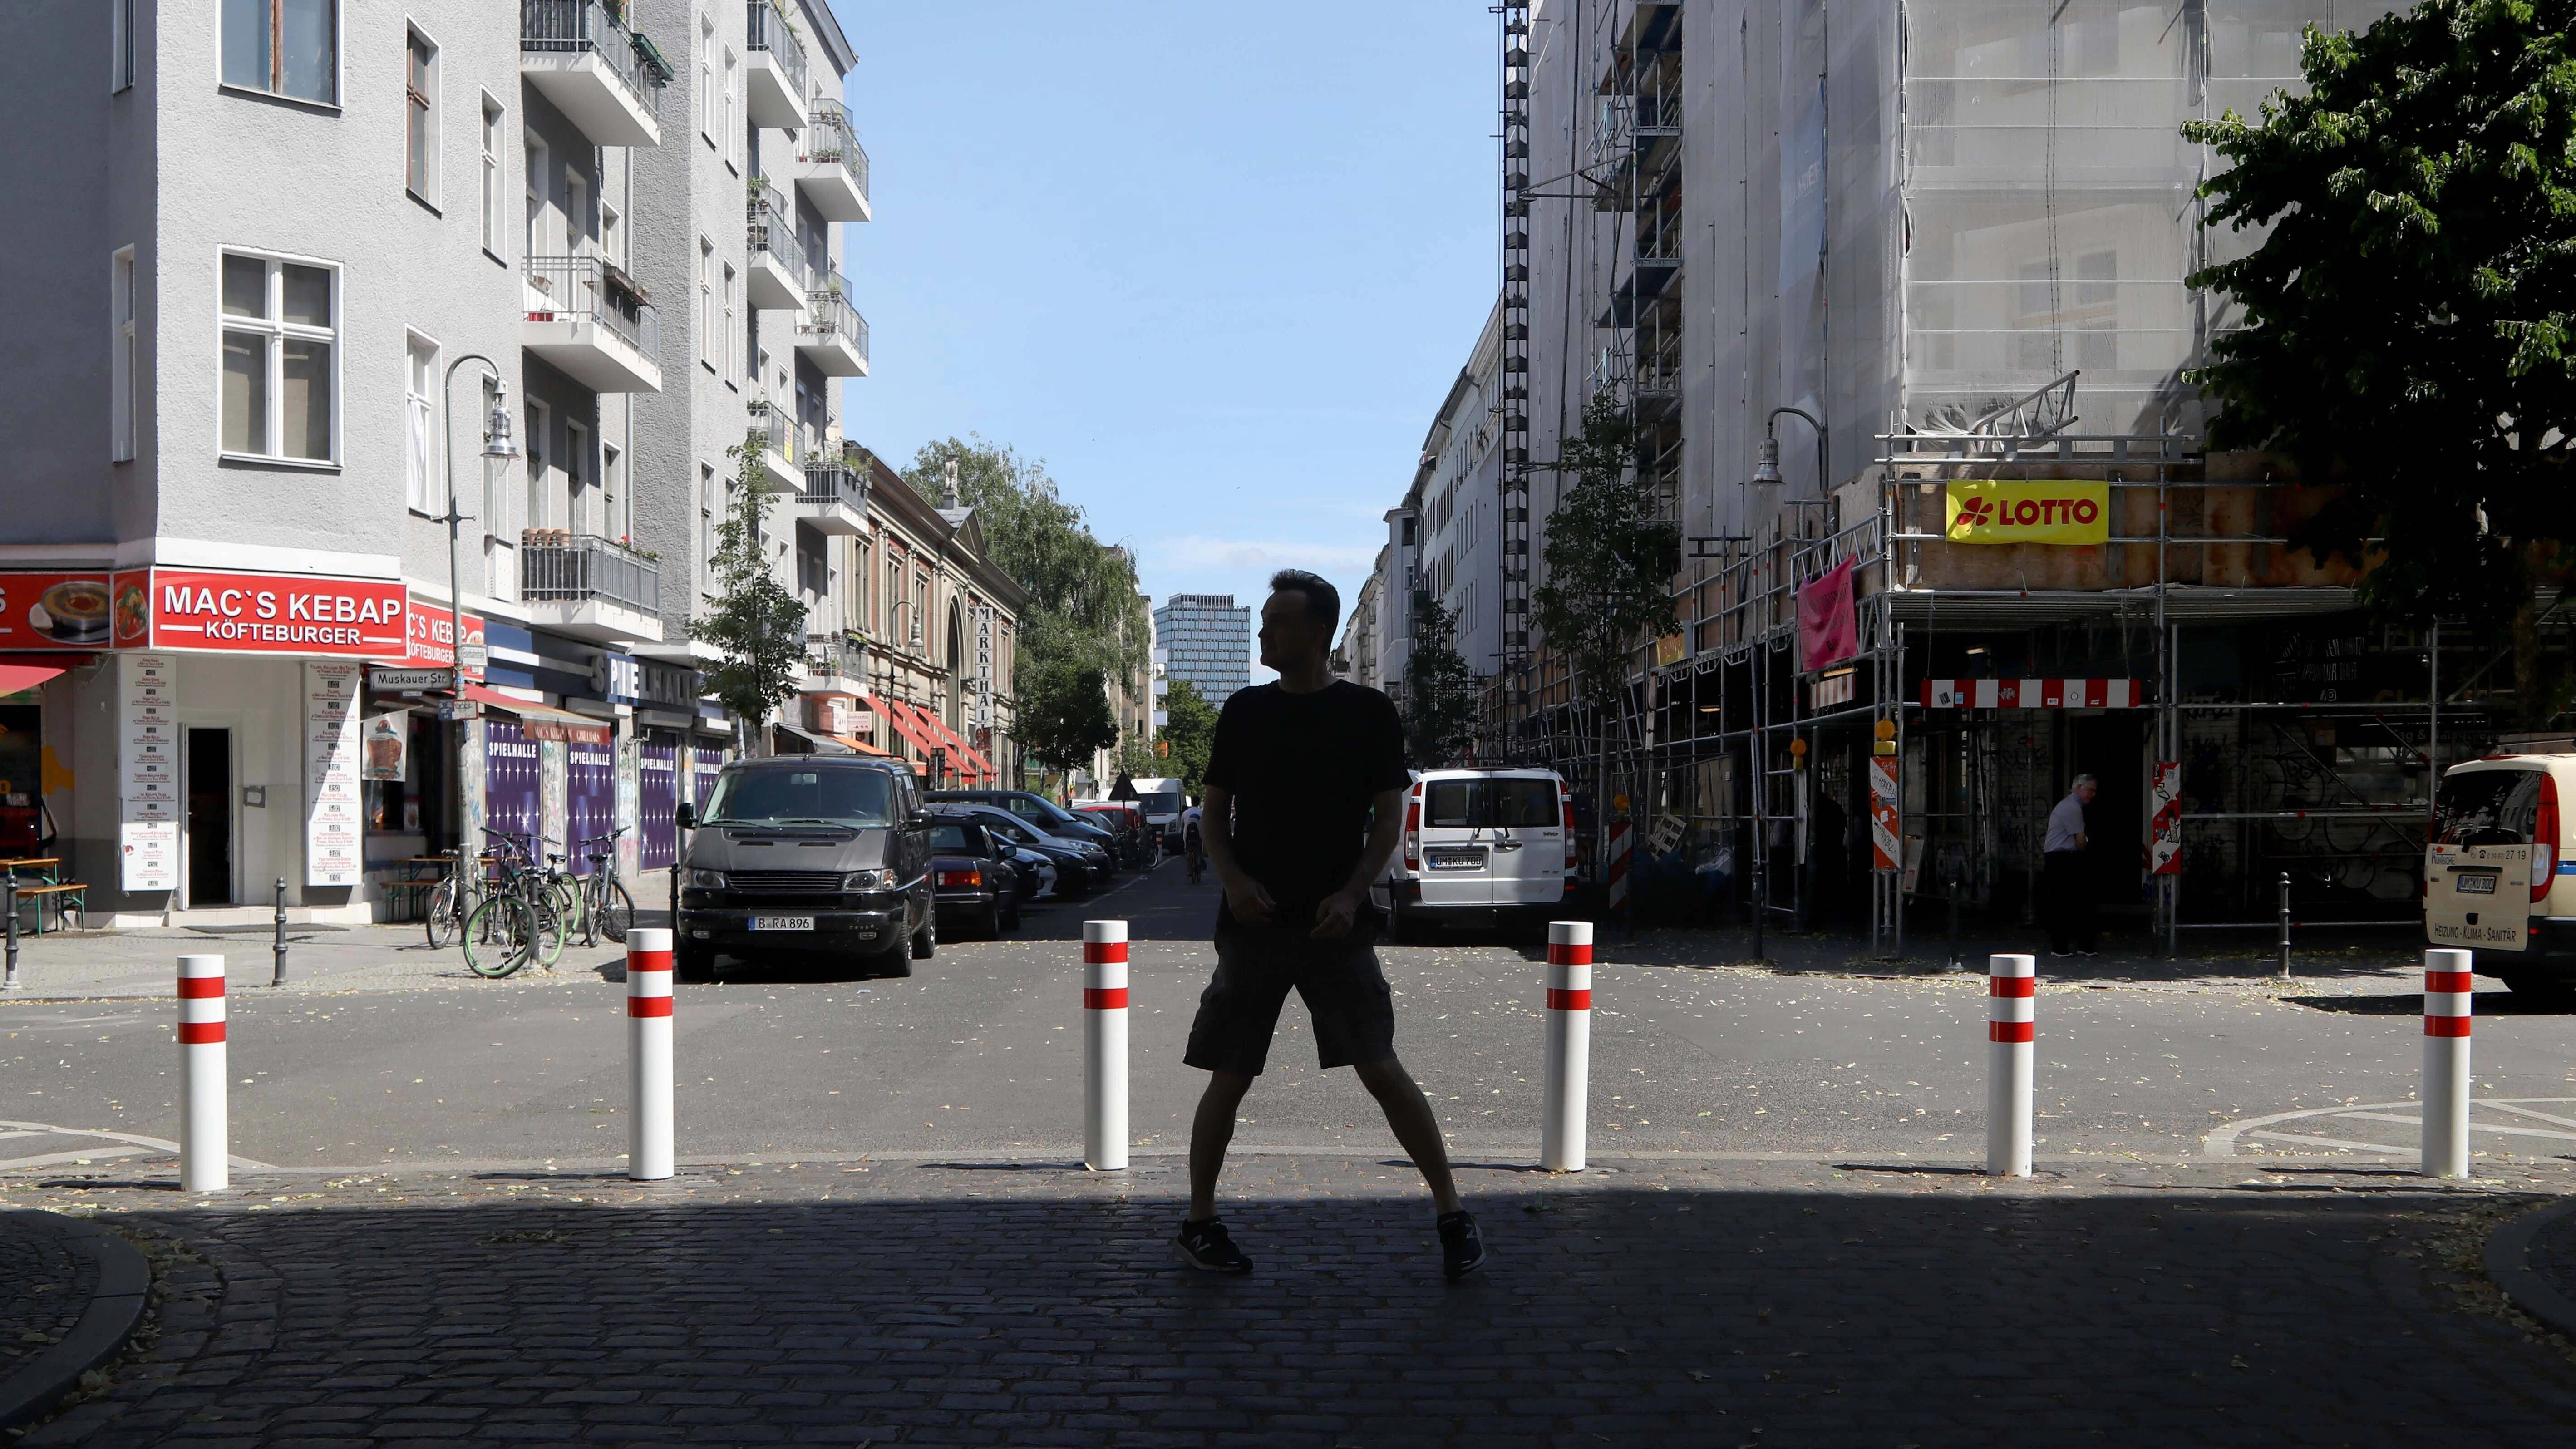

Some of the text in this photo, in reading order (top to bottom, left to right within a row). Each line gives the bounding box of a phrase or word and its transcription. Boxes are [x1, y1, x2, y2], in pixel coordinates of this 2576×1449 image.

[1999, 498, 2098, 526] LOTTO
[289, 593, 401, 625] KEBAP
[205, 619, 361, 645] KÖFTEBURGER
[378, 673, 447, 684] Muskauer Str.
[488, 742, 537, 759] SPIELHALLE
[570, 751, 610, 767] SPIELHALLE
[640, 757, 674, 771] SPIELHALLE
[1436, 856, 1482, 866] UM KU 700
[2505, 850, 2514, 860] 27
[2517, 850, 2527, 860] 19
[2481, 878, 2494, 890] 300
[759, 918, 809, 928] B RA 896
[2434, 923, 2459, 938] HEIZUNG
[2463, 926, 2482, 940] KLIMA
[2487, 927, 2516, 943] SANITÄR
